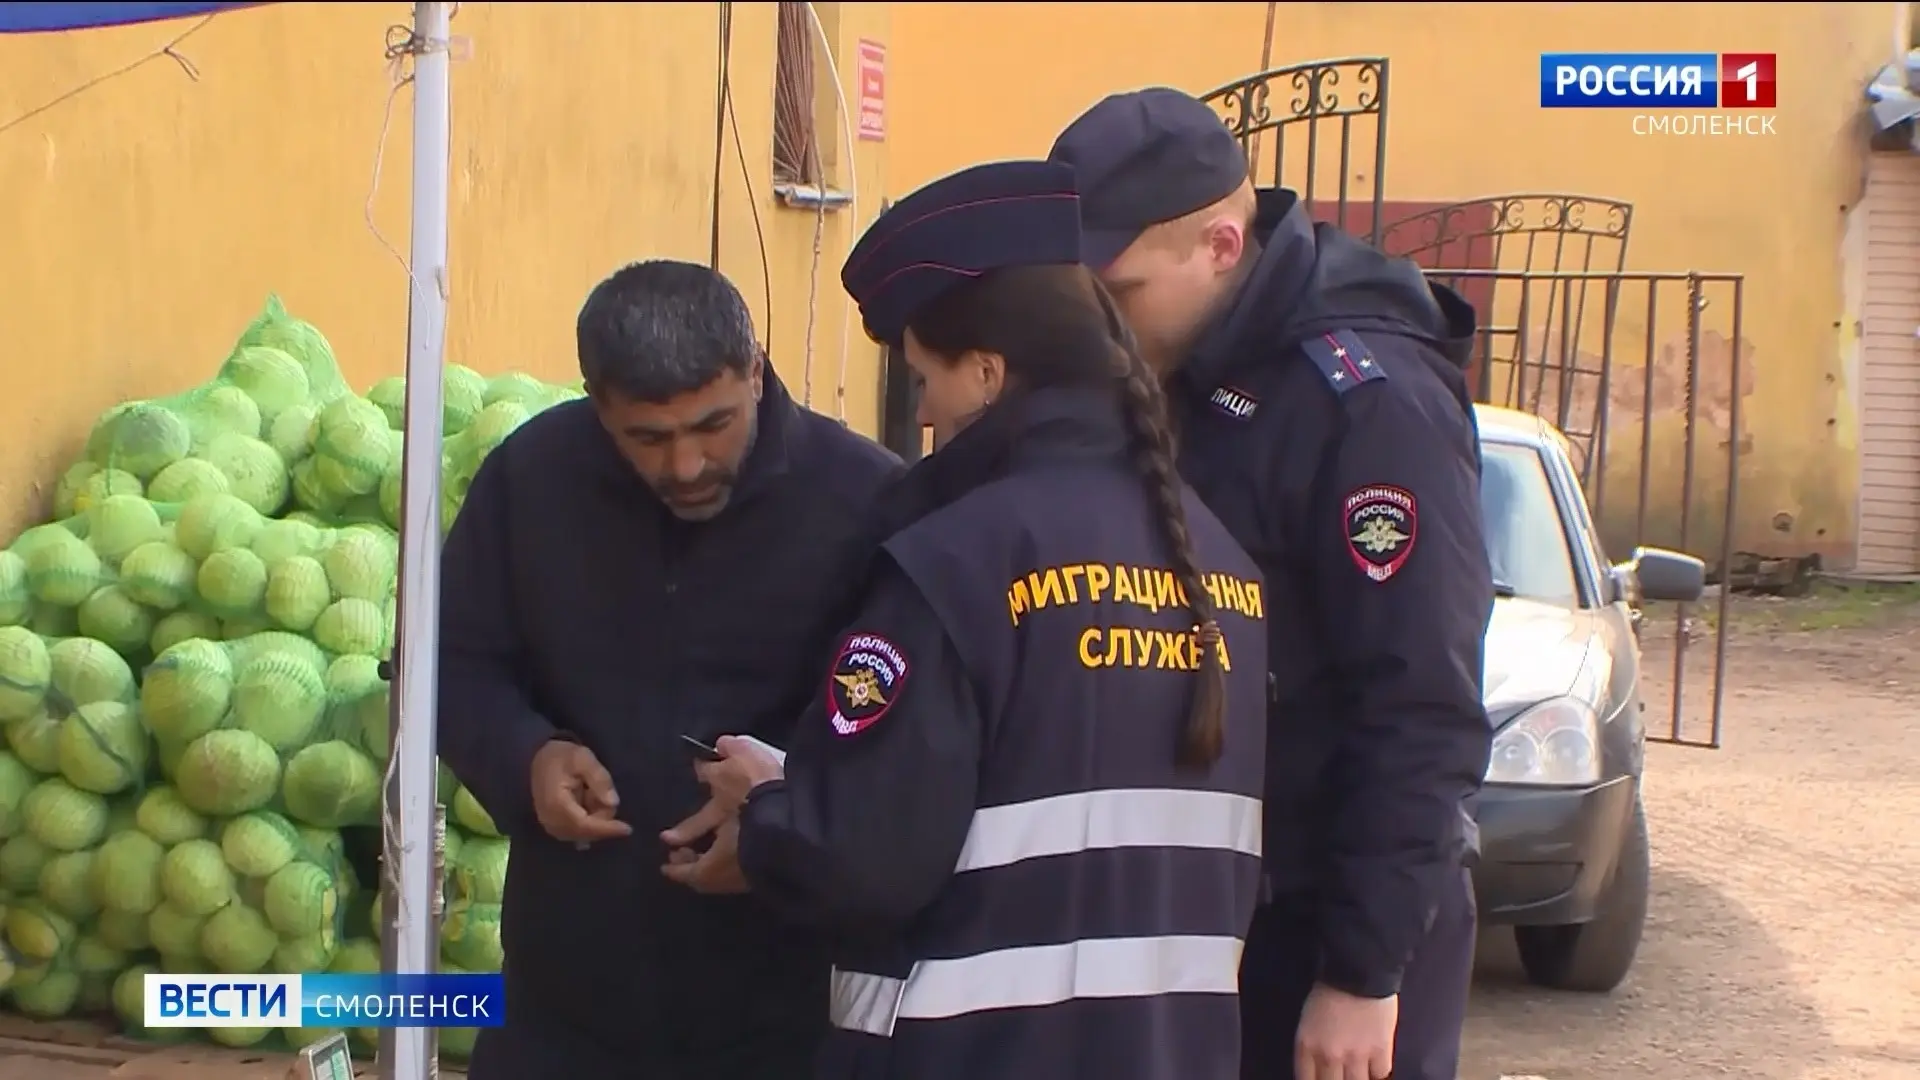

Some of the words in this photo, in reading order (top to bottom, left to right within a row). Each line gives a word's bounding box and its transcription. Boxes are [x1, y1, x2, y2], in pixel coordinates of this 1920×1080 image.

[1211, 387, 1258, 416] ЛИЦИ
[1347, 488, 1411, 509] ПОЛИЦИЯ
[1354, 504, 1405, 523] РОССИЯ
[848, 652, 895, 687] РОССИЯ
[850, 636, 907, 677] ПОЛИЦИЯ
[831, 710, 859, 735] МВД
